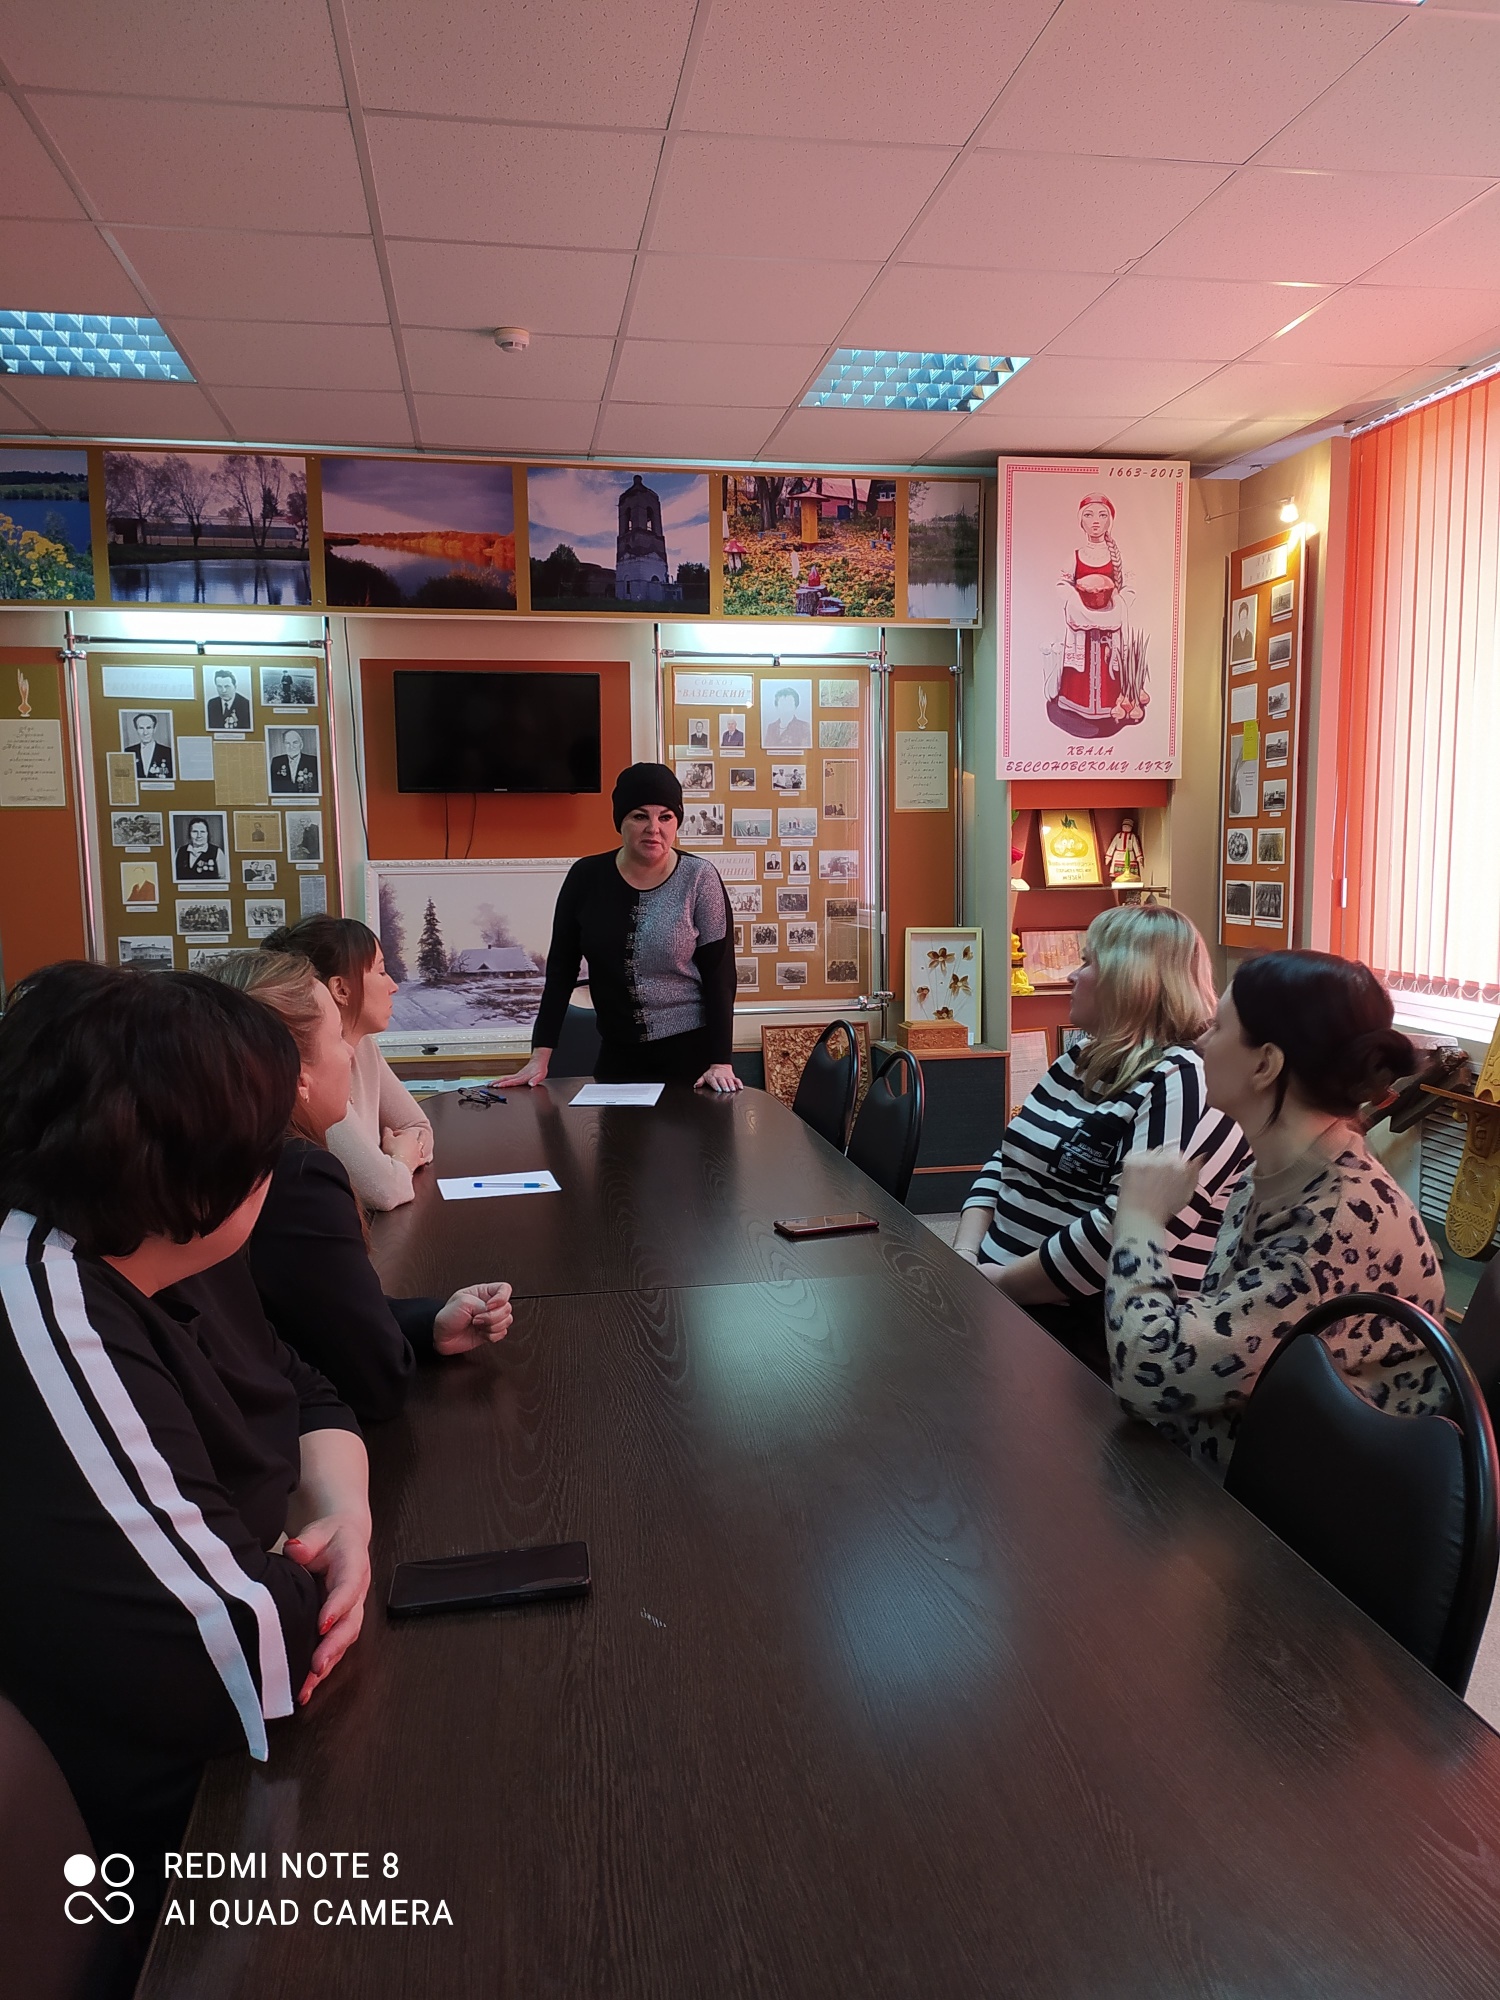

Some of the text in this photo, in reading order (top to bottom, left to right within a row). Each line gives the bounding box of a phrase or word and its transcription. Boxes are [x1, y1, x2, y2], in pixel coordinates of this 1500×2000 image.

[1109, 467, 1184, 478] 1663-2013
[1067, 745, 1115, 756] ХВАЛА
[1006, 760, 1174, 773] БЕССОНОВСКОМУ ЛУКУ
